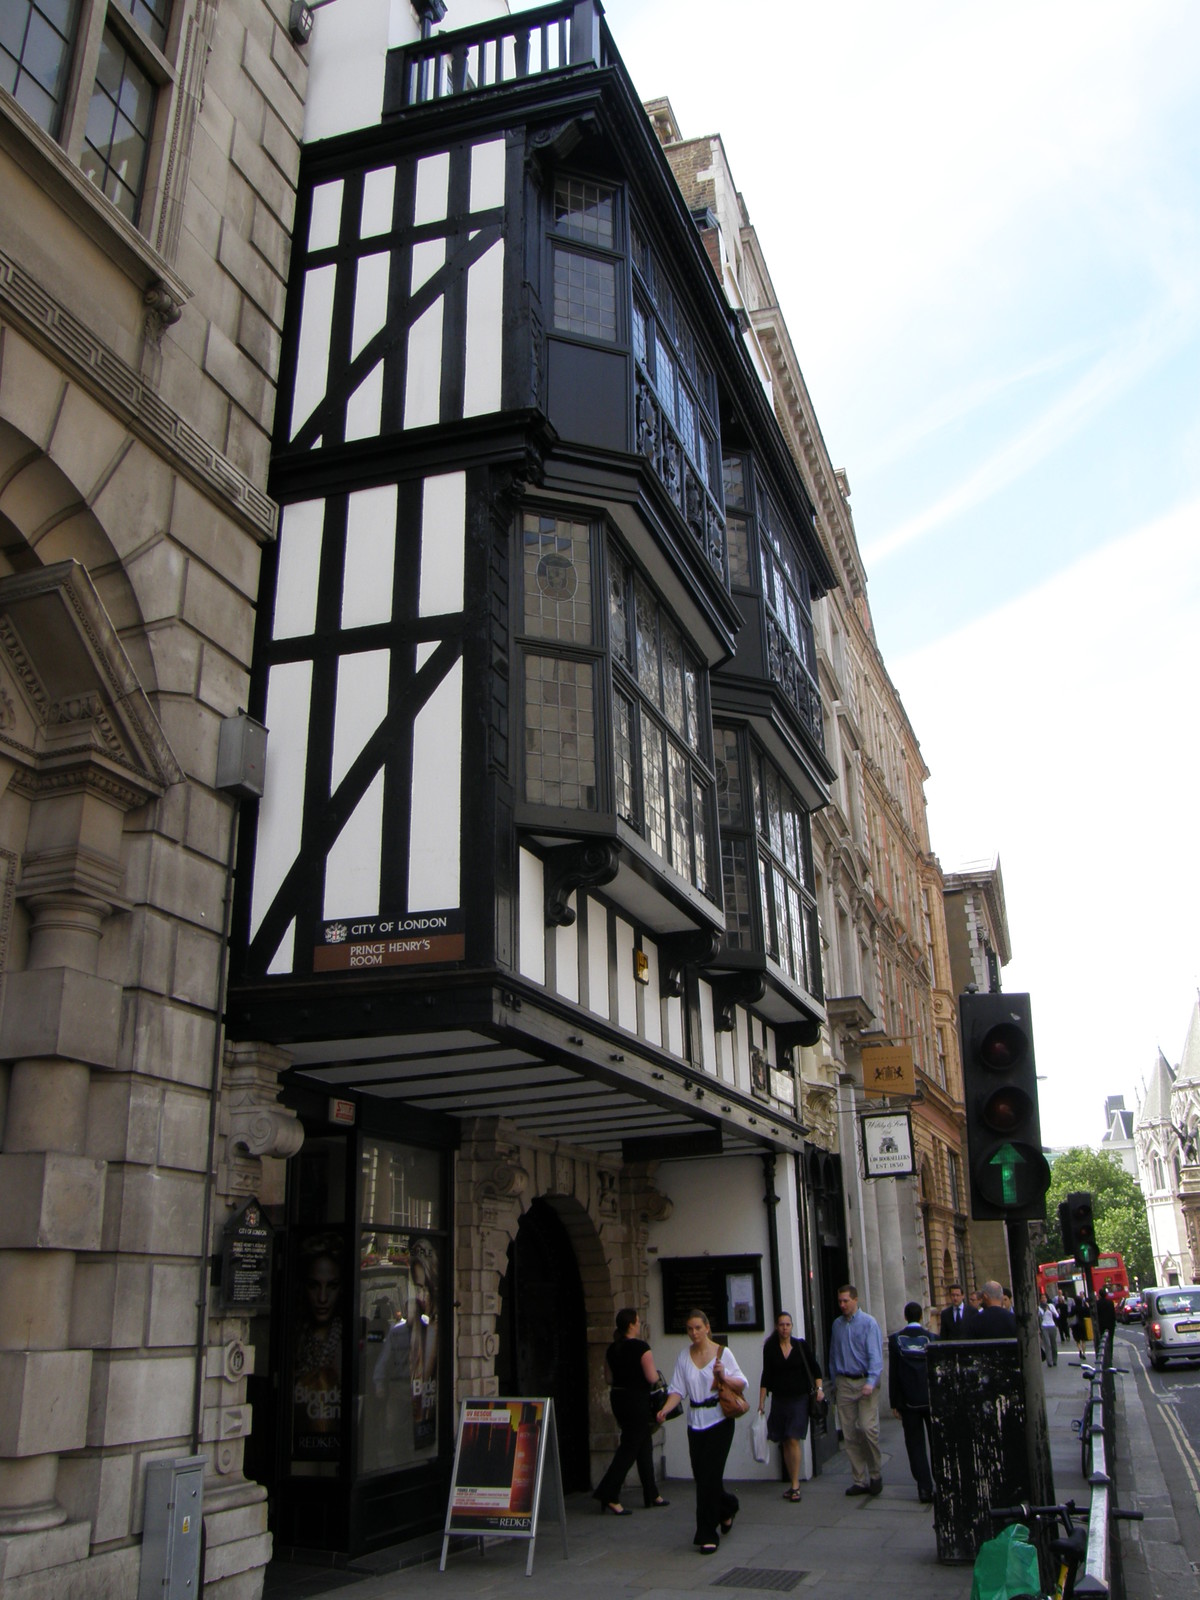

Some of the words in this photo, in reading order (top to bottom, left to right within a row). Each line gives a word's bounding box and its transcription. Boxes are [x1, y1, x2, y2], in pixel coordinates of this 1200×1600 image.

[351, 923, 376, 935] CITY
[379, 921, 395, 933] OF
[398, 917, 447, 931] LONDON
[350, 943, 385, 956] PRINCE
[388, 939, 431, 953] HENRY'S
[350, 954, 383, 967] ROOM
[879, 1154, 910, 1162] BOOKSELLERS
[499, 1517, 533, 1528] REDKEN
